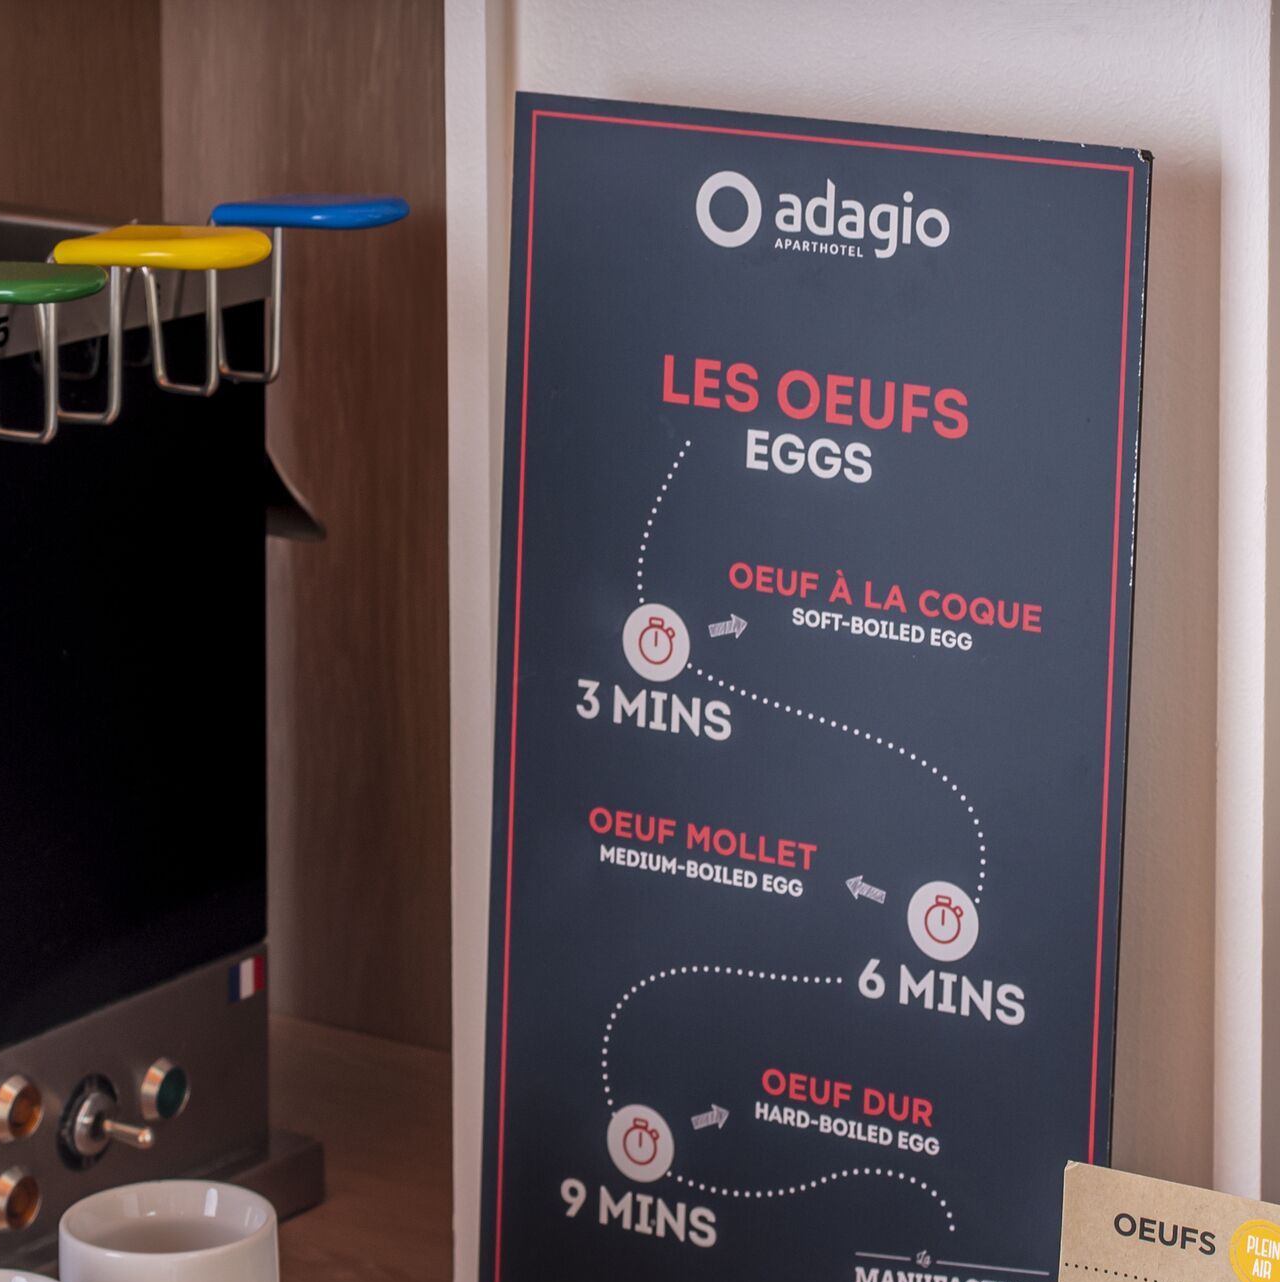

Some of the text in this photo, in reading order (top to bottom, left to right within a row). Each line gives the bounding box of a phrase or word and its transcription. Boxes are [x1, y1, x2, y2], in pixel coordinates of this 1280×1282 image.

[774, 178, 950, 258] adagio
[774, 238, 864, 258] APARTHOTEL
[662, 354, 969, 440] LES OEUFS
[745, 429, 873, 484] EGGS
[728, 562, 1043, 633] OEUF À LA COQUE
[791, 607, 973, 652] SOFT-BOILED EGG
[575, 679, 732, 741] 3 MINS
[588, 806, 817, 870] OEUF MOLLET
[599, 844, 803, 898] MEDIUM-BOILED EGG
[858, 958, 1026, 1026] 6 MINS
[761, 1067, 934, 1127] OEUF DUR
[755, 1102, 940, 1156] HARD-BOILED EGG
[560, 1178, 718, 1248] 9 MINS
[1113, 1212, 1217, 1256] OEUFS
[915, 1249, 932, 1269] La
[1246, 1234, 1280, 1261] PLEIN
[1251, 1258, 1272, 1280] AIR
